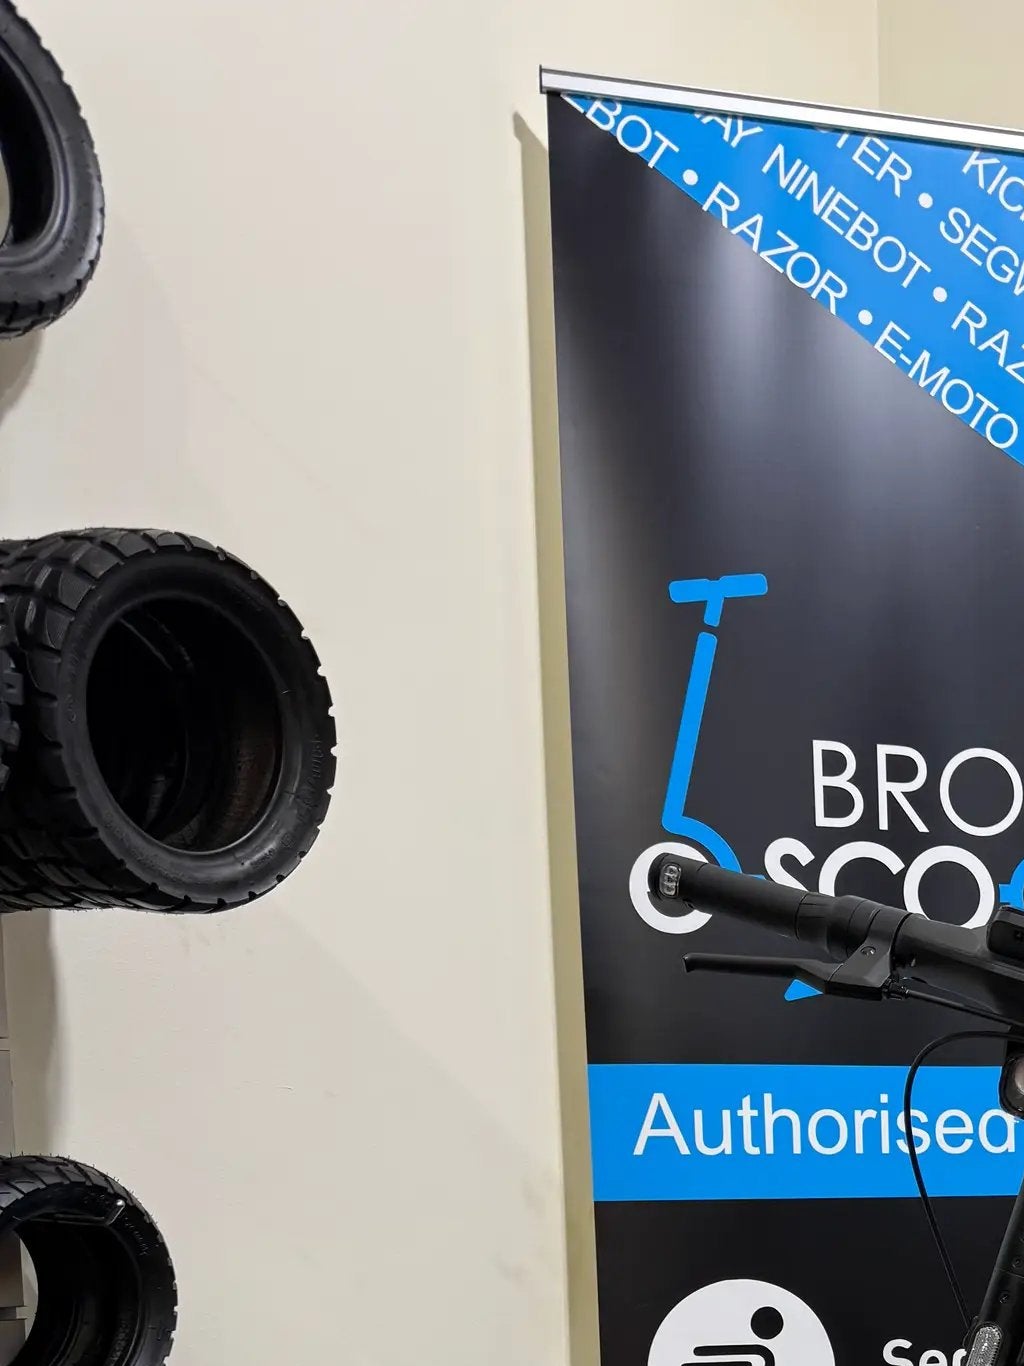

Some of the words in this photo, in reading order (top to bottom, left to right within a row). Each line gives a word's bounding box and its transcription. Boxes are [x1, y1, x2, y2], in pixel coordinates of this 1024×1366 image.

[762, 143, 932, 289] NINEBOT
[701, 181, 848, 316] RAZOR
[873, 320, 1018, 449] E-MOTO
[632, 1091, 1018, 1156] Authorised
